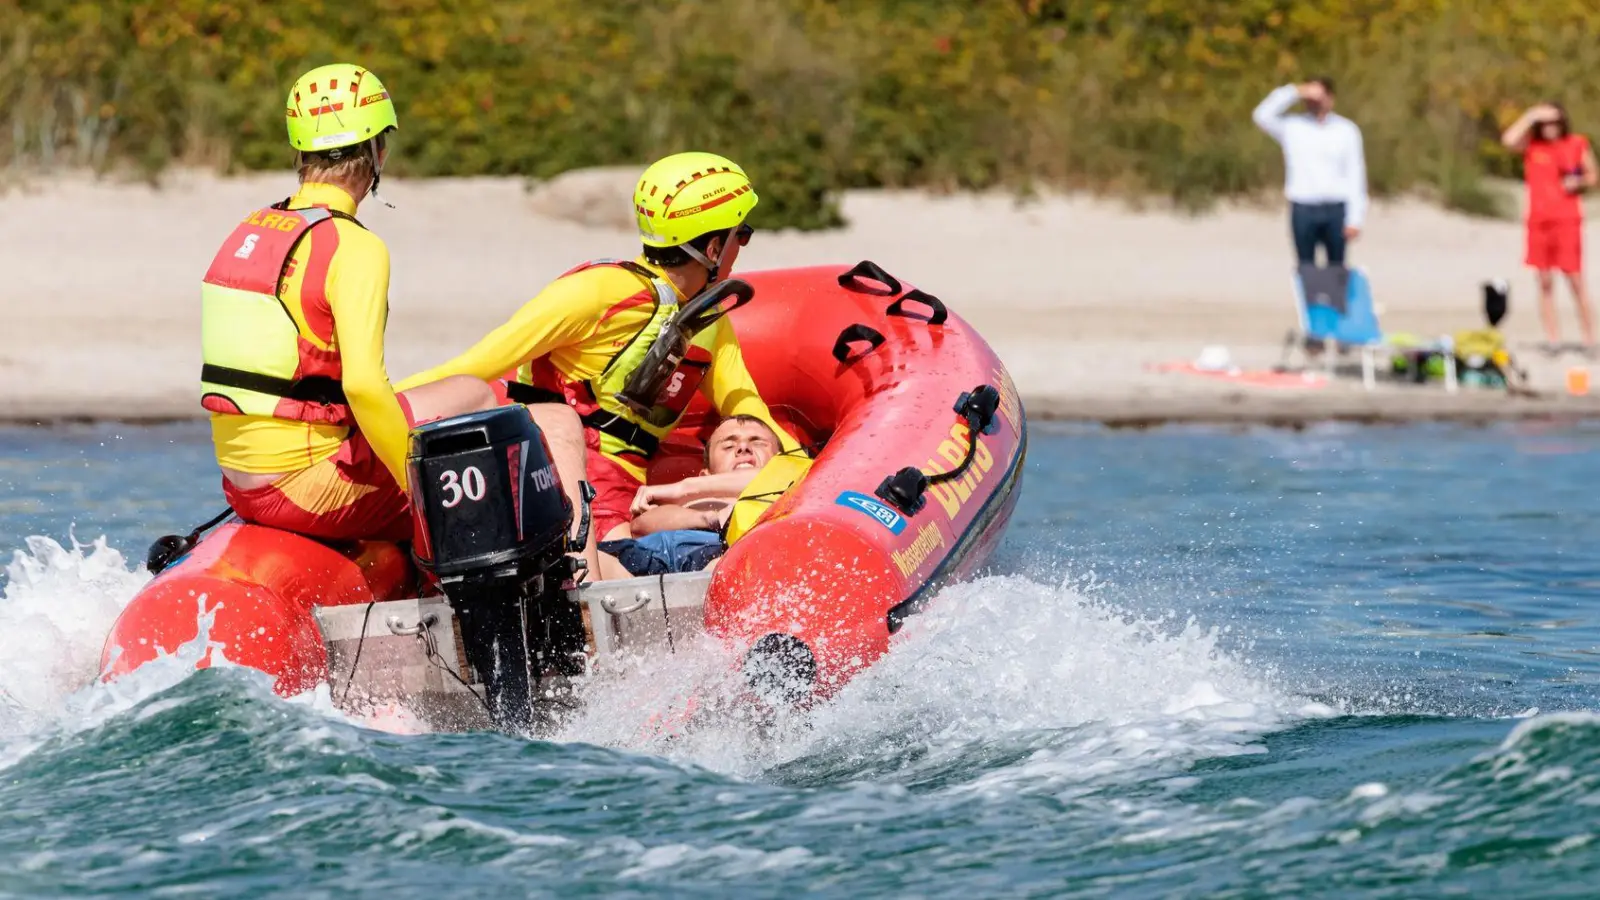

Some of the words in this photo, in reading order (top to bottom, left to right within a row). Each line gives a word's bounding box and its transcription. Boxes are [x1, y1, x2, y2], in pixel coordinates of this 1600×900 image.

[702, 187, 726, 200] DLRG
[439, 466, 487, 509] 30
[922, 423, 994, 521] DLRG
